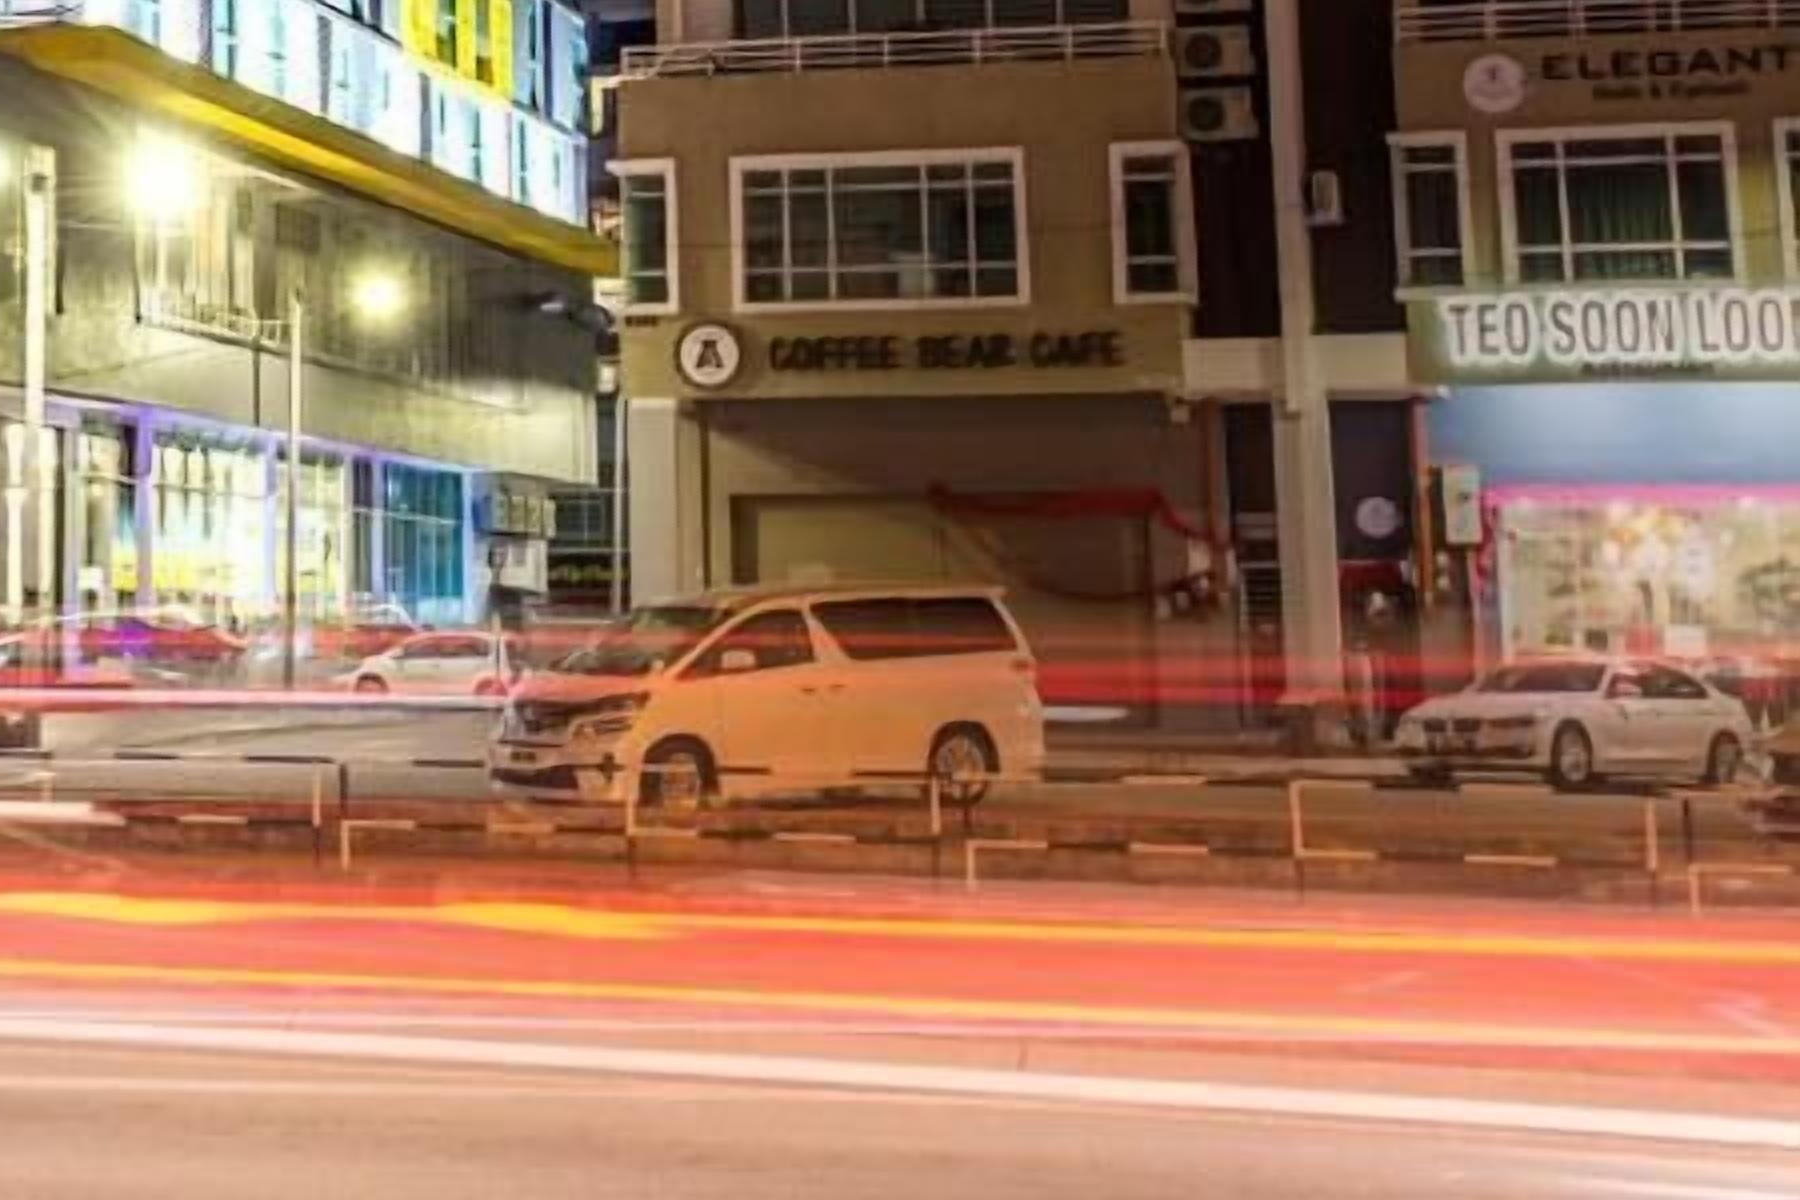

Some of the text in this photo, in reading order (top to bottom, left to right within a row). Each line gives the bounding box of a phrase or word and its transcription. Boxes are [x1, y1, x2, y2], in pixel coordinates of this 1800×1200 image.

[1541, 46, 1797, 80] ELEGANT
[1448, 302, 1531, 356] TEO
[1550, 299, 1677, 356] SOON
[769, 335, 902, 370] COFFEE
[1030, 330, 1127, 367] CAFE
